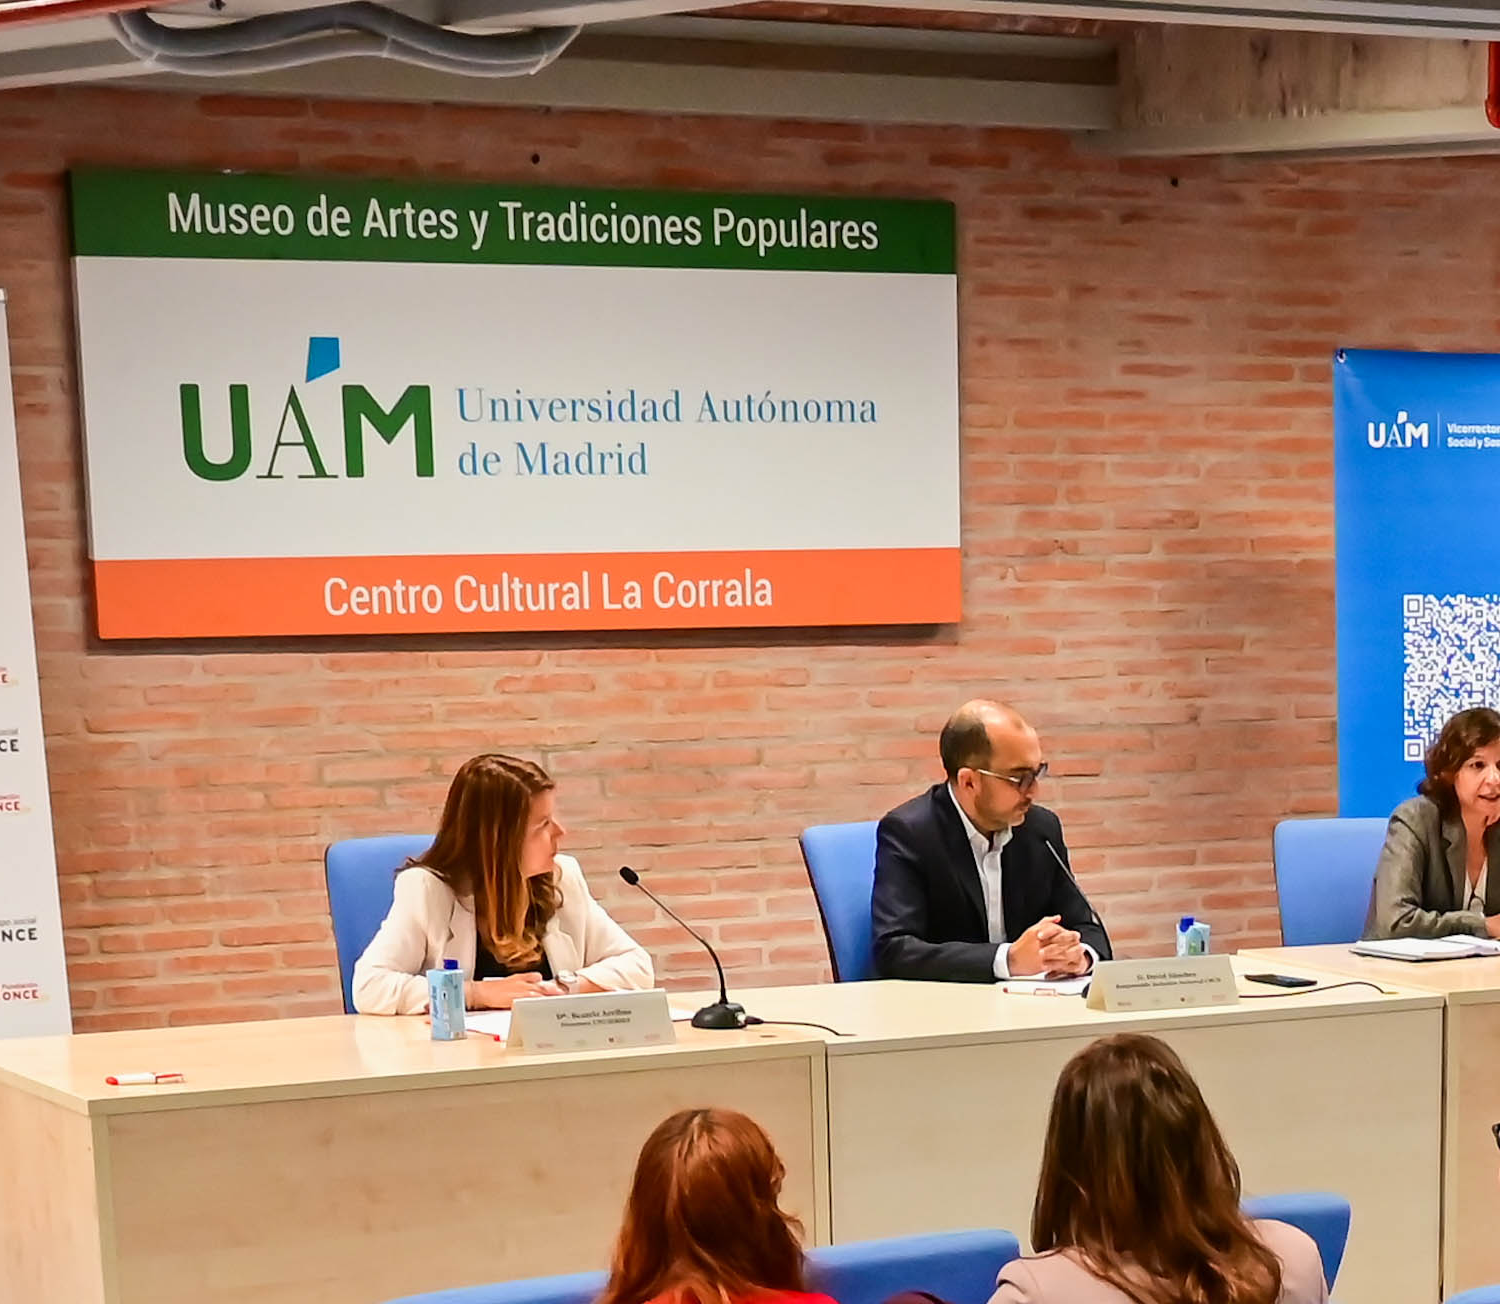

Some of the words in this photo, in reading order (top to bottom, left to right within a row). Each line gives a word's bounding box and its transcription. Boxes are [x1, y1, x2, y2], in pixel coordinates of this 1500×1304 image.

[169, 193, 294, 235] Museo
[306, 194, 350, 237] de
[363, 198, 458, 239] Artes
[468, 211, 488, 250] y
[499, 201, 701, 246] Tradiciones
[714, 208, 878, 256] Populares
[458, 388, 680, 422] Universidad
[701, 391, 876, 423] Autónoma
[459, 442, 500, 475] de
[516, 442, 646, 475] Madrid
[1448, 437, 1476, 448] Social
[324, 577, 443, 616] Centro
[455, 571, 590, 613] Cultural
[602, 573, 642, 609] La
[654, 568, 772, 608] Corrala
[3, 990, 38, 1000] ONCE
